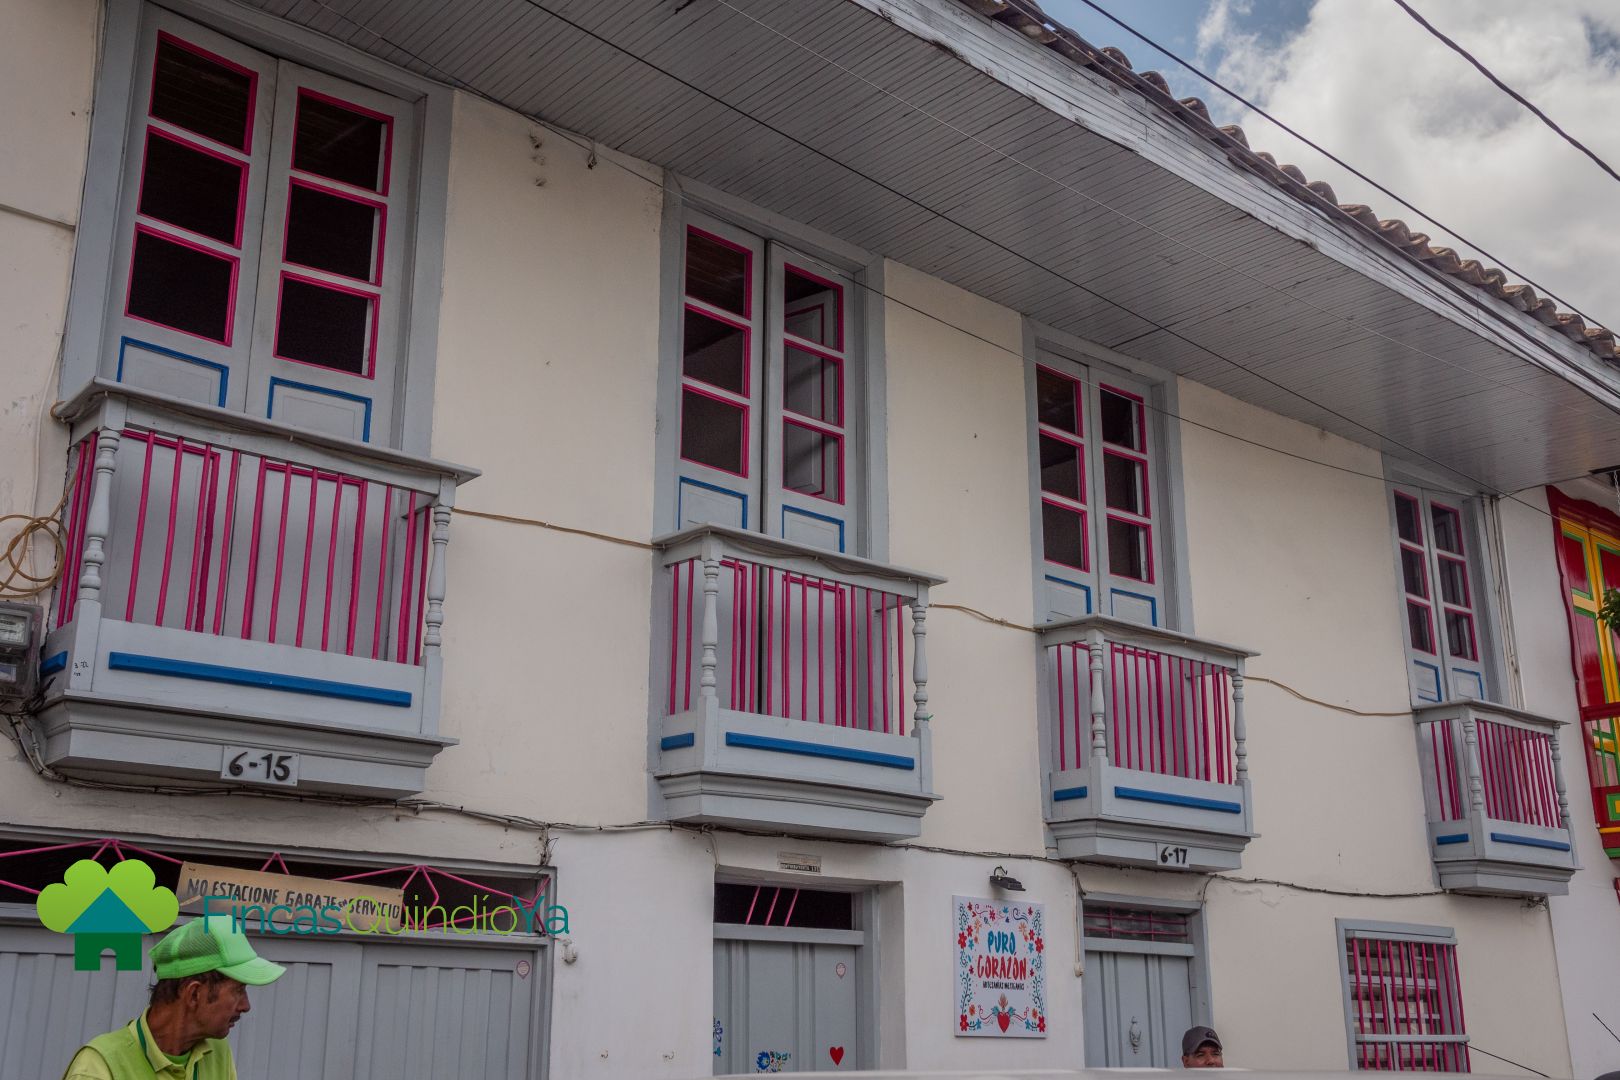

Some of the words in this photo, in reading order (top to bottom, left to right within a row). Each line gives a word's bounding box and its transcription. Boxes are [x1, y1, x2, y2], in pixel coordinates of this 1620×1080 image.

[229, 751, 292, 781] 6-15
[1161, 846, 1187, 864] 6-17
[186, 878, 208, 897] NO
[212, 881, 279, 905] ESTACIONE
[285, 890, 337, 911] GARAJE
[348, 898, 400, 919] SERVICIO
[987, 930, 1016, 954] PURO
[977, 952, 1026, 980] CORAZÓN
